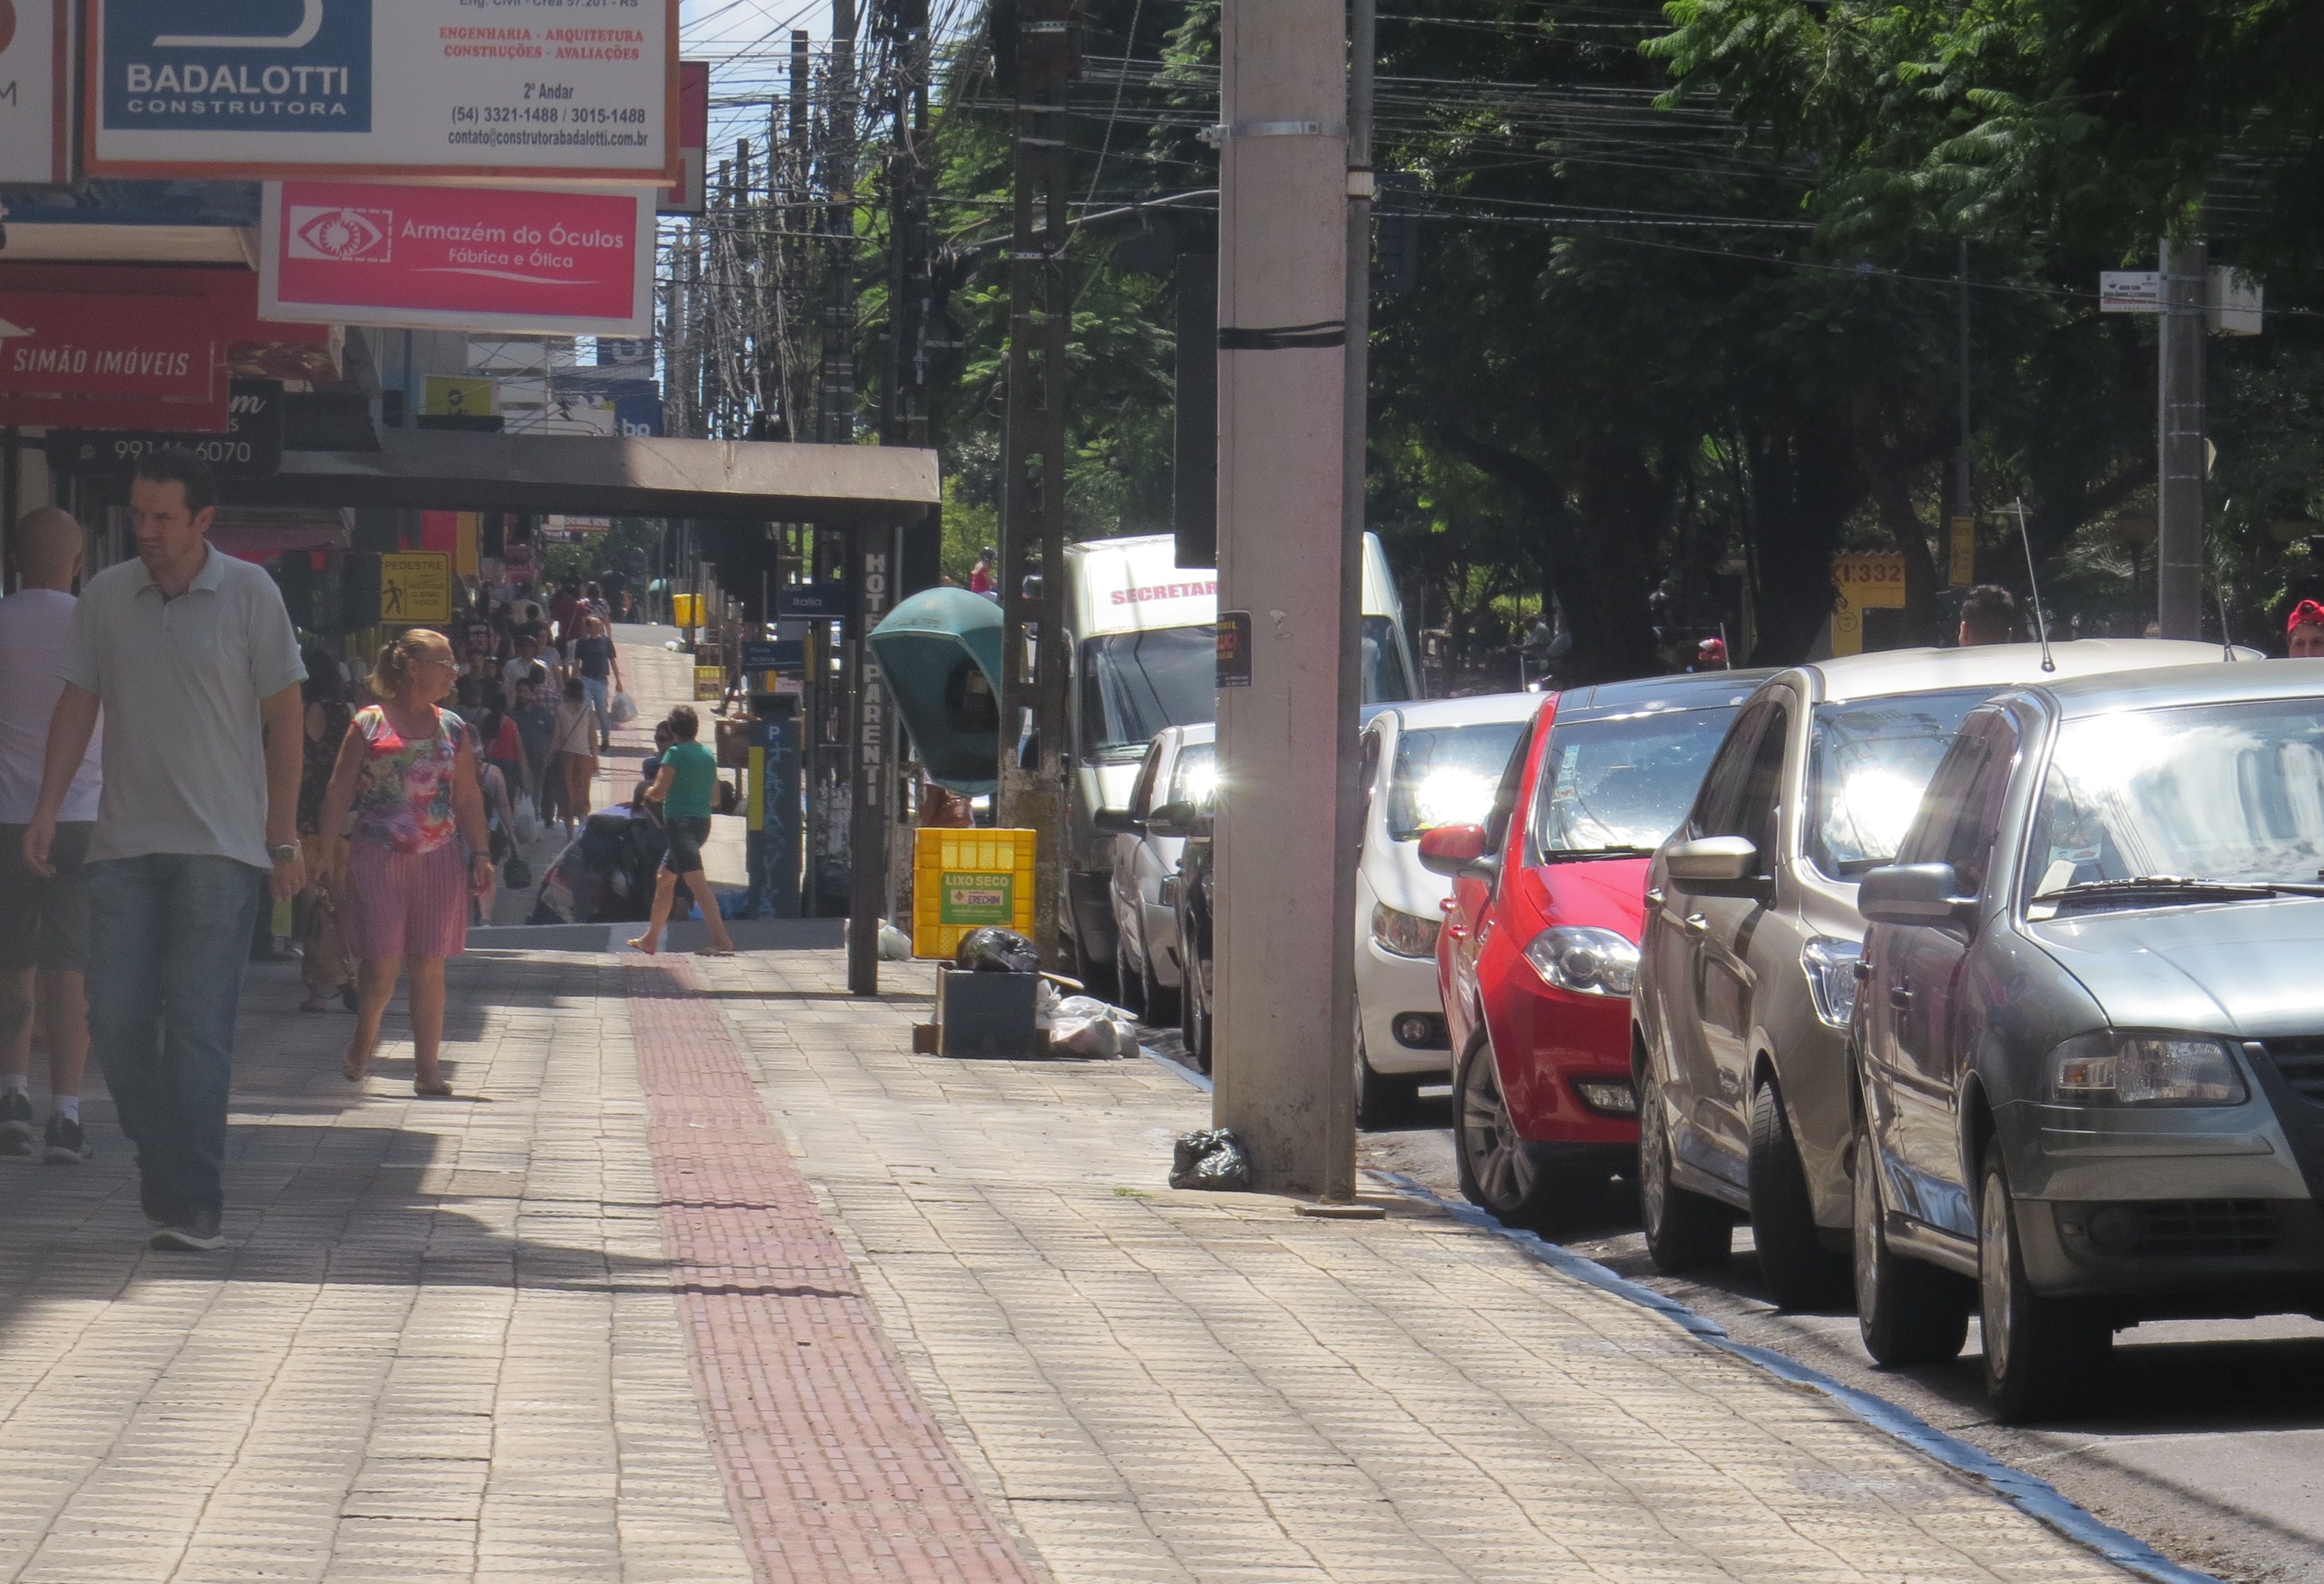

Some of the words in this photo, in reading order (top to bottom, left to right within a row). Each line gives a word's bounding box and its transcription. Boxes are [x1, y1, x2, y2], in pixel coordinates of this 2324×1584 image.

[439, 27, 531, 41] ENGENHARIA
[545, 29, 644, 43] ARQUITETURA
[443, 43, 543, 59] CONSTRUÇÕES
[555, 45, 640, 62] AVALIAÇÕES
[128, 64, 348, 95] BADALOTTI
[538, 83, 574, 100] Andar
[127, 99, 347, 115] CONSTRUTORA
[451, 107, 479, 125] (54)
[484, 108, 558, 124] 3321-1488
[571, 108, 645, 124] 3015-1488
[448, 128, 648, 147] contato@construtorabadalotti.com.br
[401, 219, 506, 243] Armazém
[513, 225, 542, 244] do
[548, 223, 624, 249] Óculos
[448, 247, 508, 266] Fábrica
[514, 255, 524, 266] e
[529, 248, 574, 269] Ótica
[13, 345, 87, 374] SIMÃO
[94, 347, 189, 376] IMÓVEIS
[385, 561, 443, 570] PEDESTRE
[1110, 581, 1217, 605] SECRETAR
[862, 664, 882, 805] PARENTI
[946, 875, 973, 885] LIXO
[976, 875, 1009, 887] SECO
[968, 895, 1000, 905] ERECHIM
